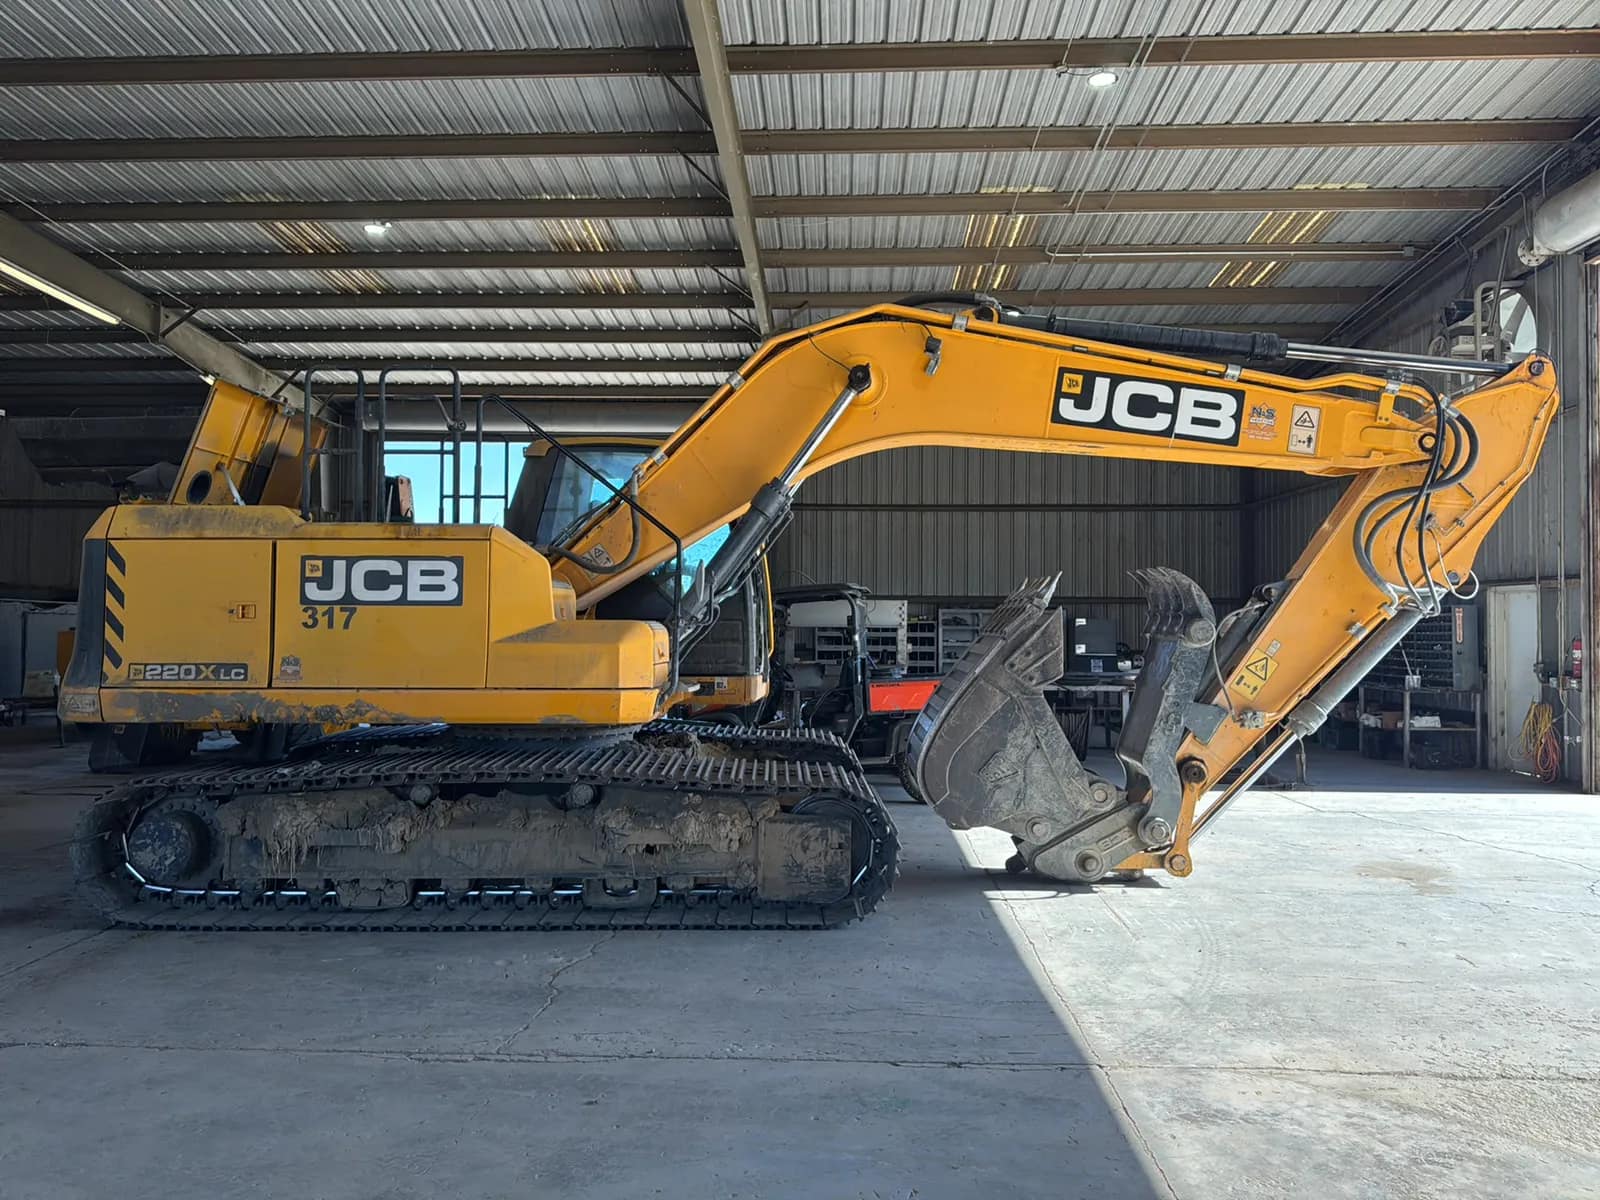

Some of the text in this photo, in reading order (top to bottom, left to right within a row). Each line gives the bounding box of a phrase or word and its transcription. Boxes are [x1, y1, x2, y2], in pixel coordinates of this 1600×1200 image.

[1058, 376, 1238, 440] JCB
[304, 559, 459, 602] JCB
[301, 606, 357, 630] 317
[145, 664, 217, 680] 220X
[220, 668, 245, 680] LC
